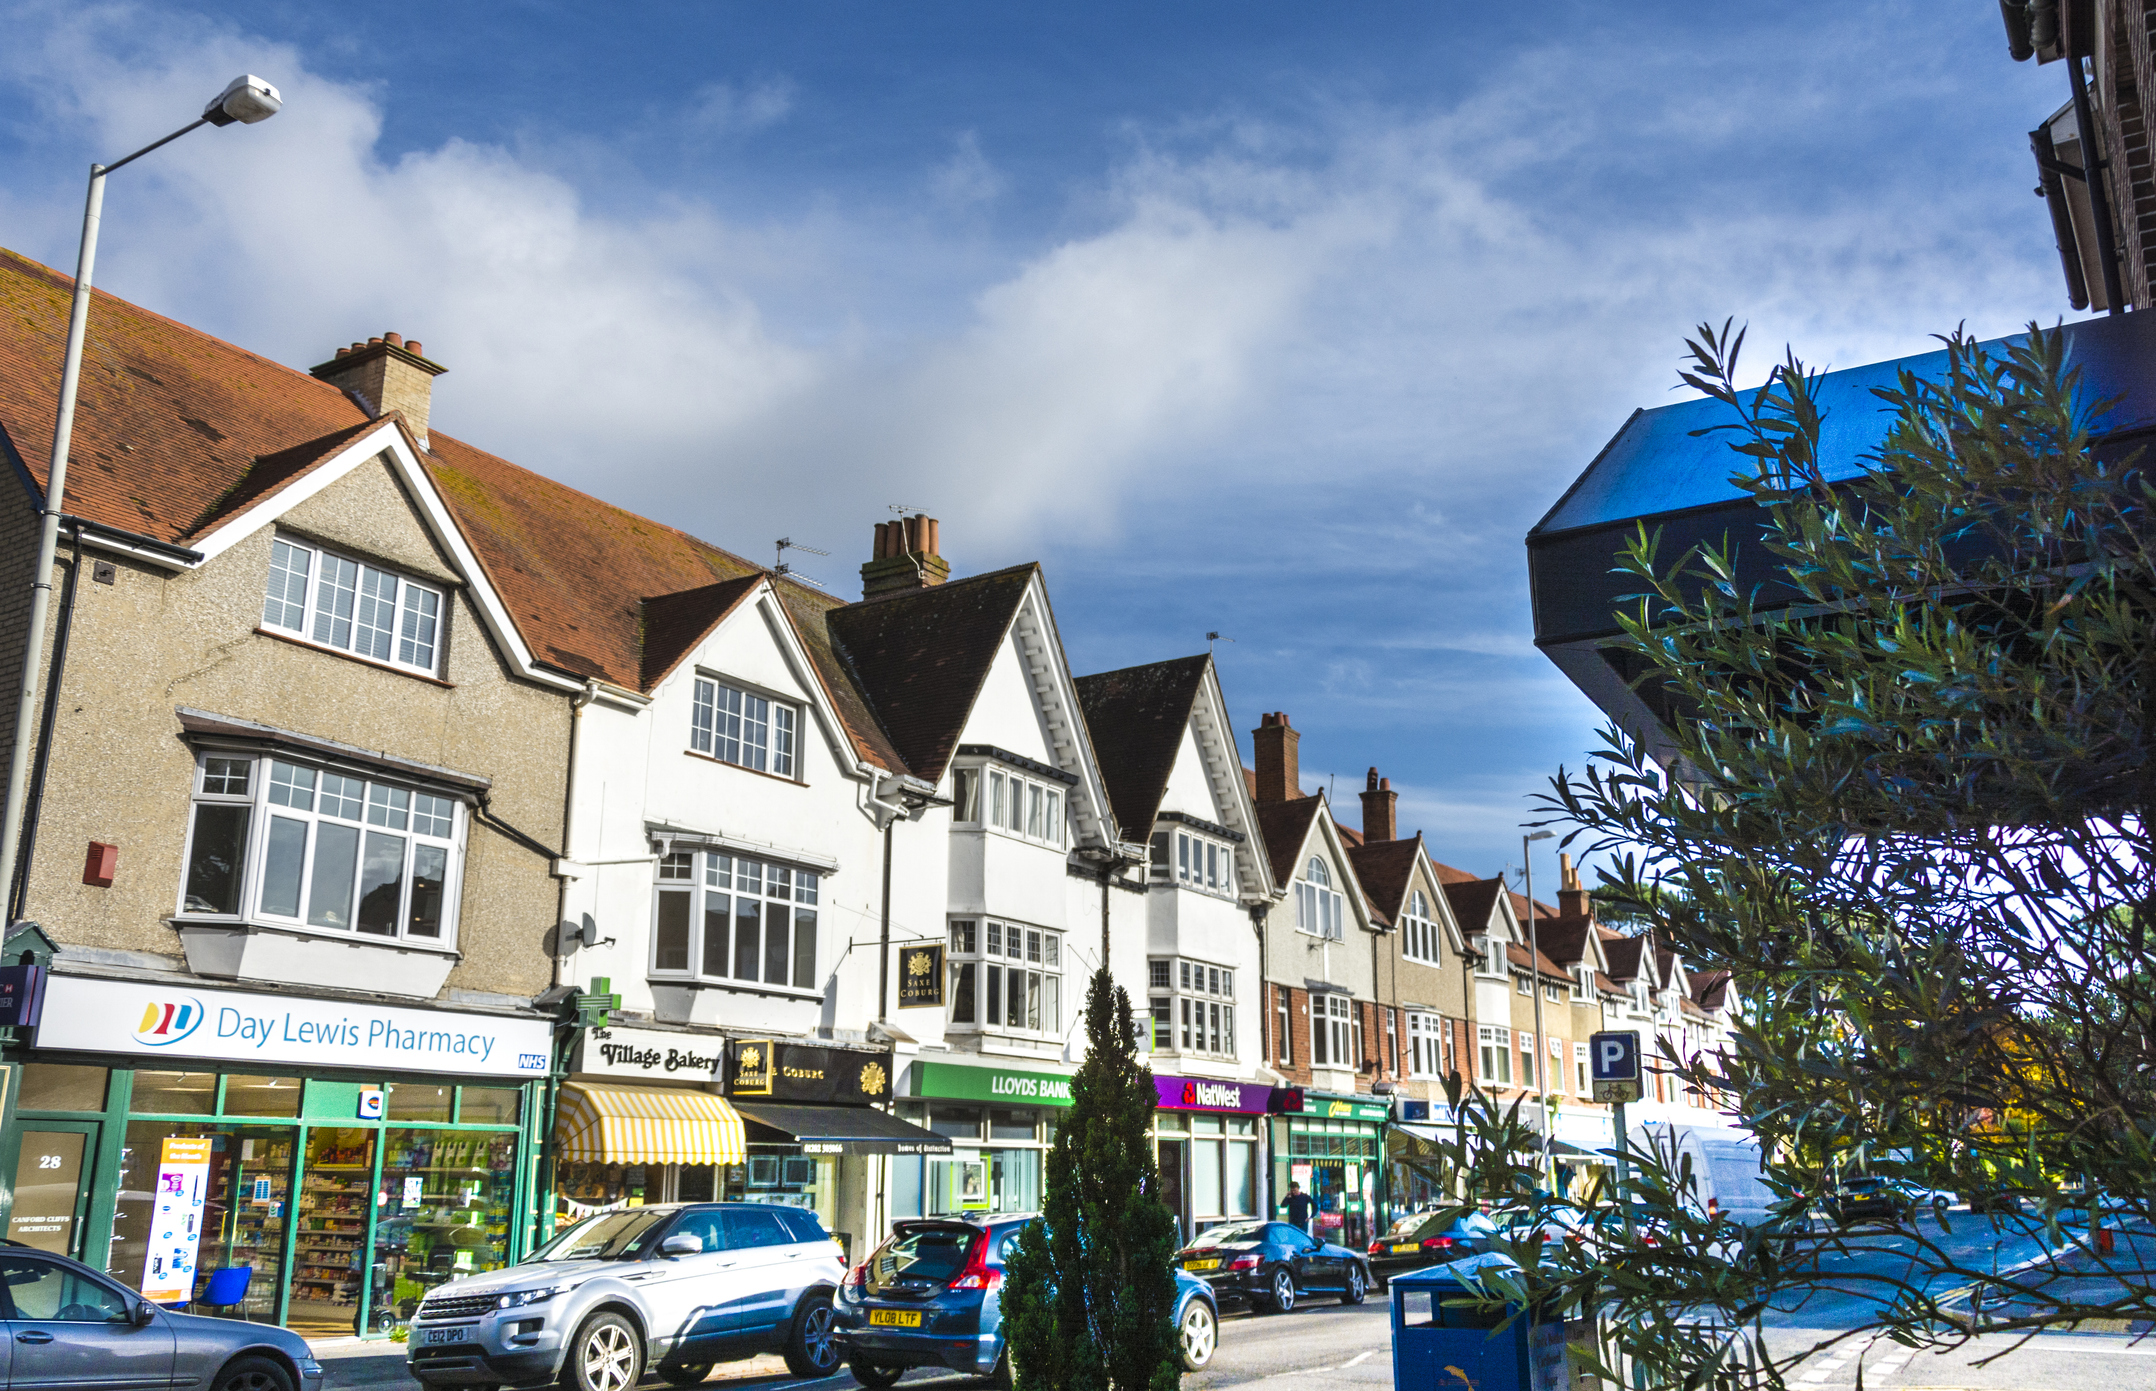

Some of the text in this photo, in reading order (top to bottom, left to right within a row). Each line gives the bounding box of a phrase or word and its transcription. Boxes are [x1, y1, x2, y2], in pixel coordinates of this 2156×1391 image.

[907, 979, 930, 987] SAXE
[900, 988, 939, 998] COBURG
[217, 1007, 495, 1062] Day Lewis Pharmacy
[591, 1027, 612, 1040] The
[519, 1055, 546, 1069] NHS
[600, 1043, 720, 1075] Village Bakery
[1600, 1040, 1625, 1073] P
[739, 1070, 758, 1078] SAXE
[733, 1078, 765, 1086] COBURG
[991, 1076, 1071, 1098] LLOYDS BANK
[1196, 1082, 1241, 1107] NatWest
[39, 1155, 62, 1169] 28
